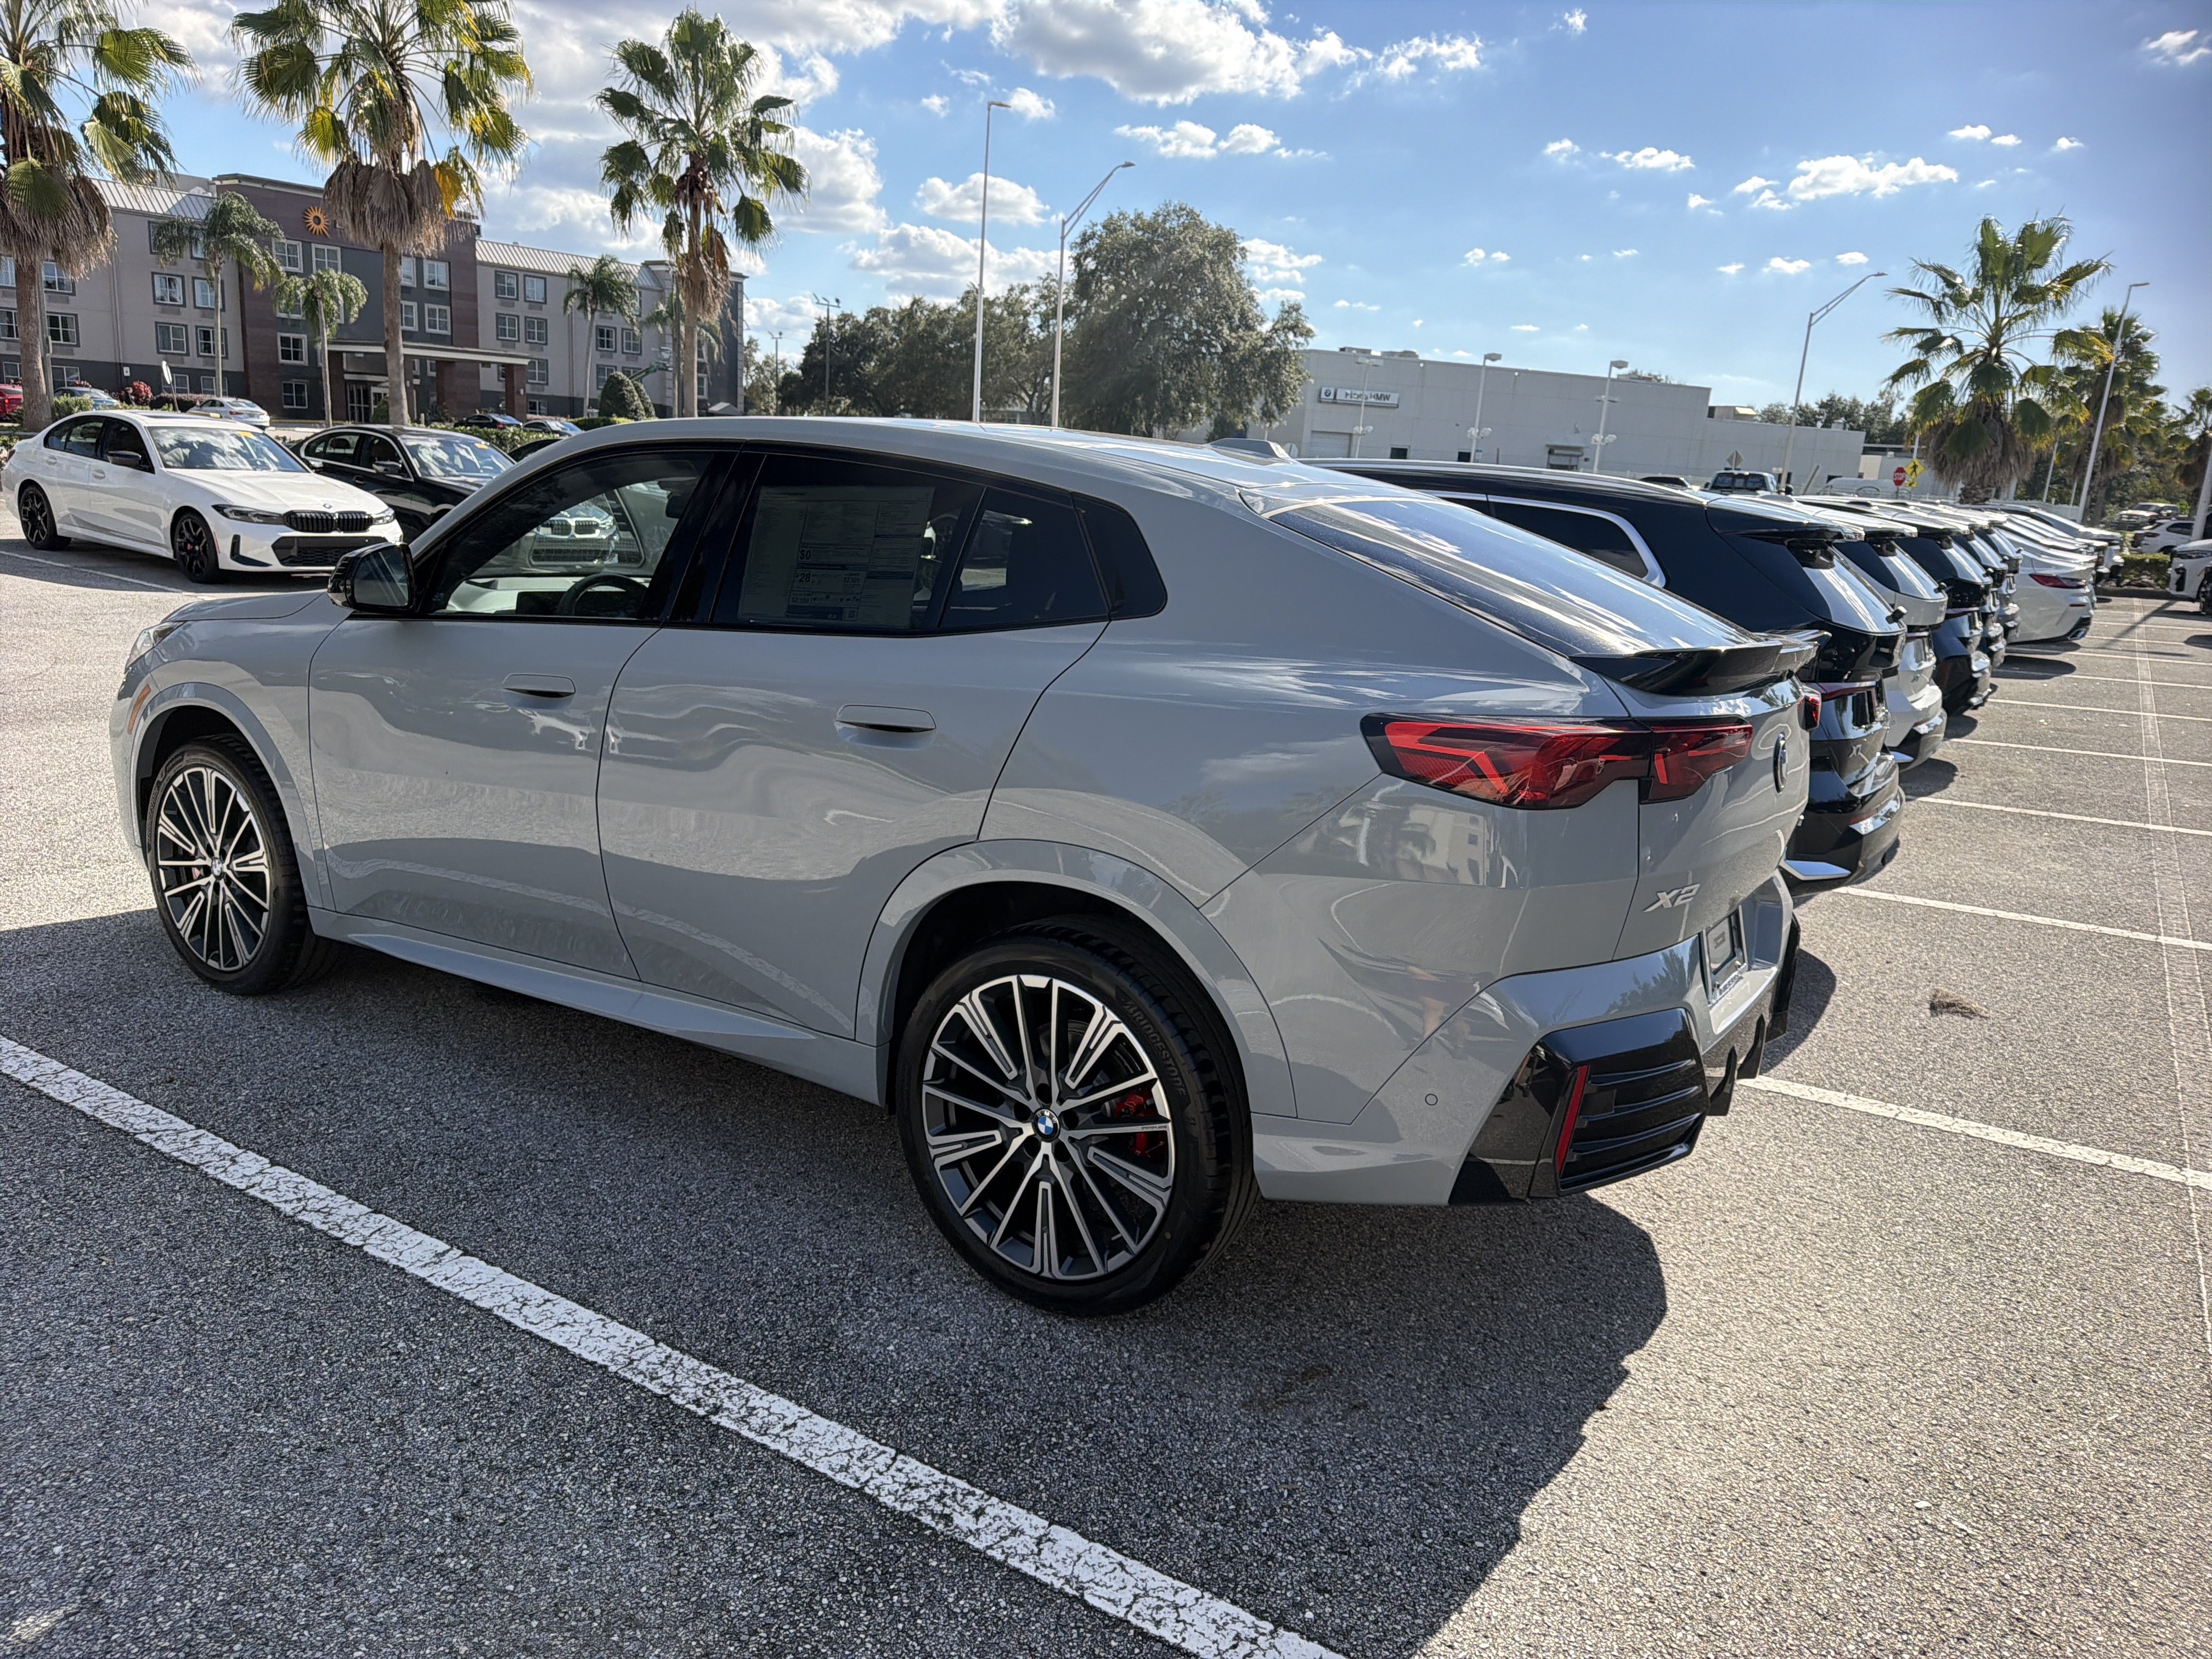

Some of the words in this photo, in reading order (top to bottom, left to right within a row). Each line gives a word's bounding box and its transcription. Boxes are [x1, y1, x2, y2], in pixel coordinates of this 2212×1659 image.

[1894, 472, 1905, 481] STOP
[799, 550, 811, 560] $0
[799, 573, 811, 583] 28
[1643, 883, 1701, 912] X2
[1124, 1002, 1187, 1096] BRIDGESTONE
